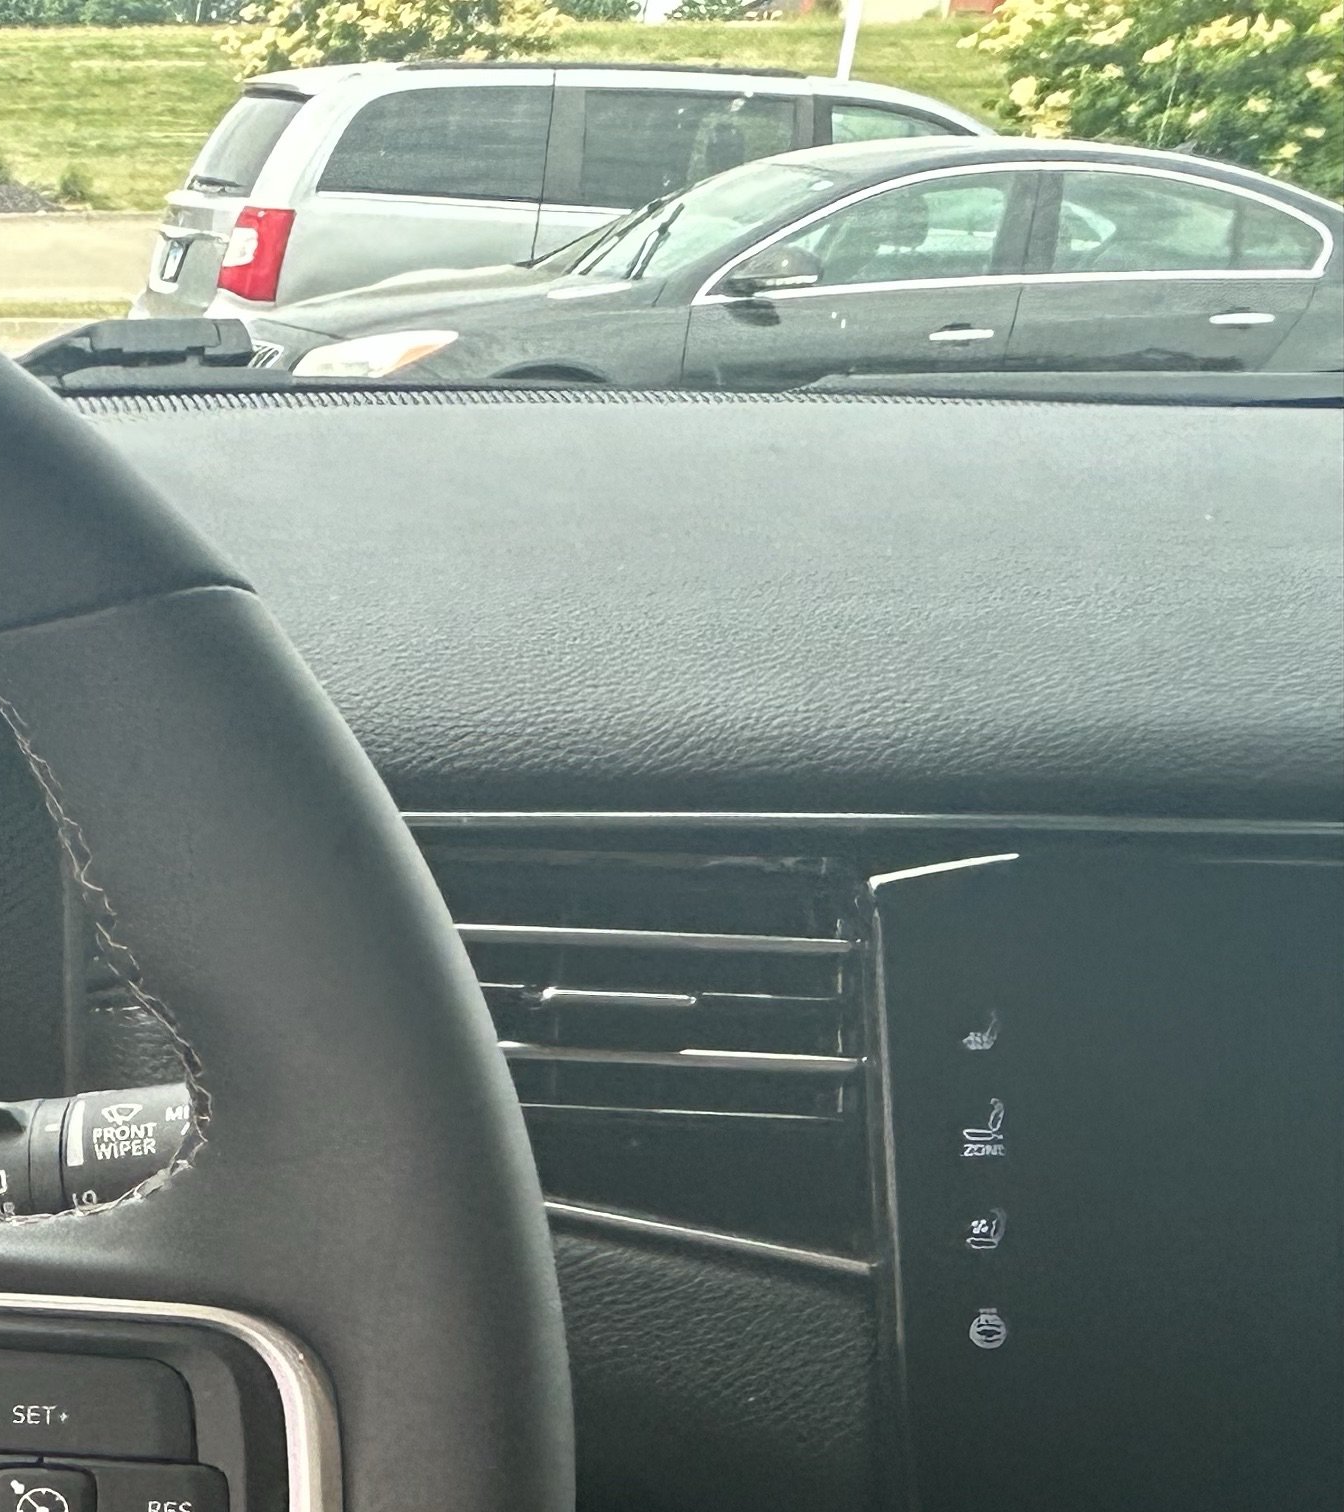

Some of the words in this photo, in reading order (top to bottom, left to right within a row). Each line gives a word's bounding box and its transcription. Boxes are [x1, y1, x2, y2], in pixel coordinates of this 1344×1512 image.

[92, 1121, 158, 1145] FRONT
[93, 1137, 157, 1161] WIPER
[11, 1404, 70, 1426] SET+
